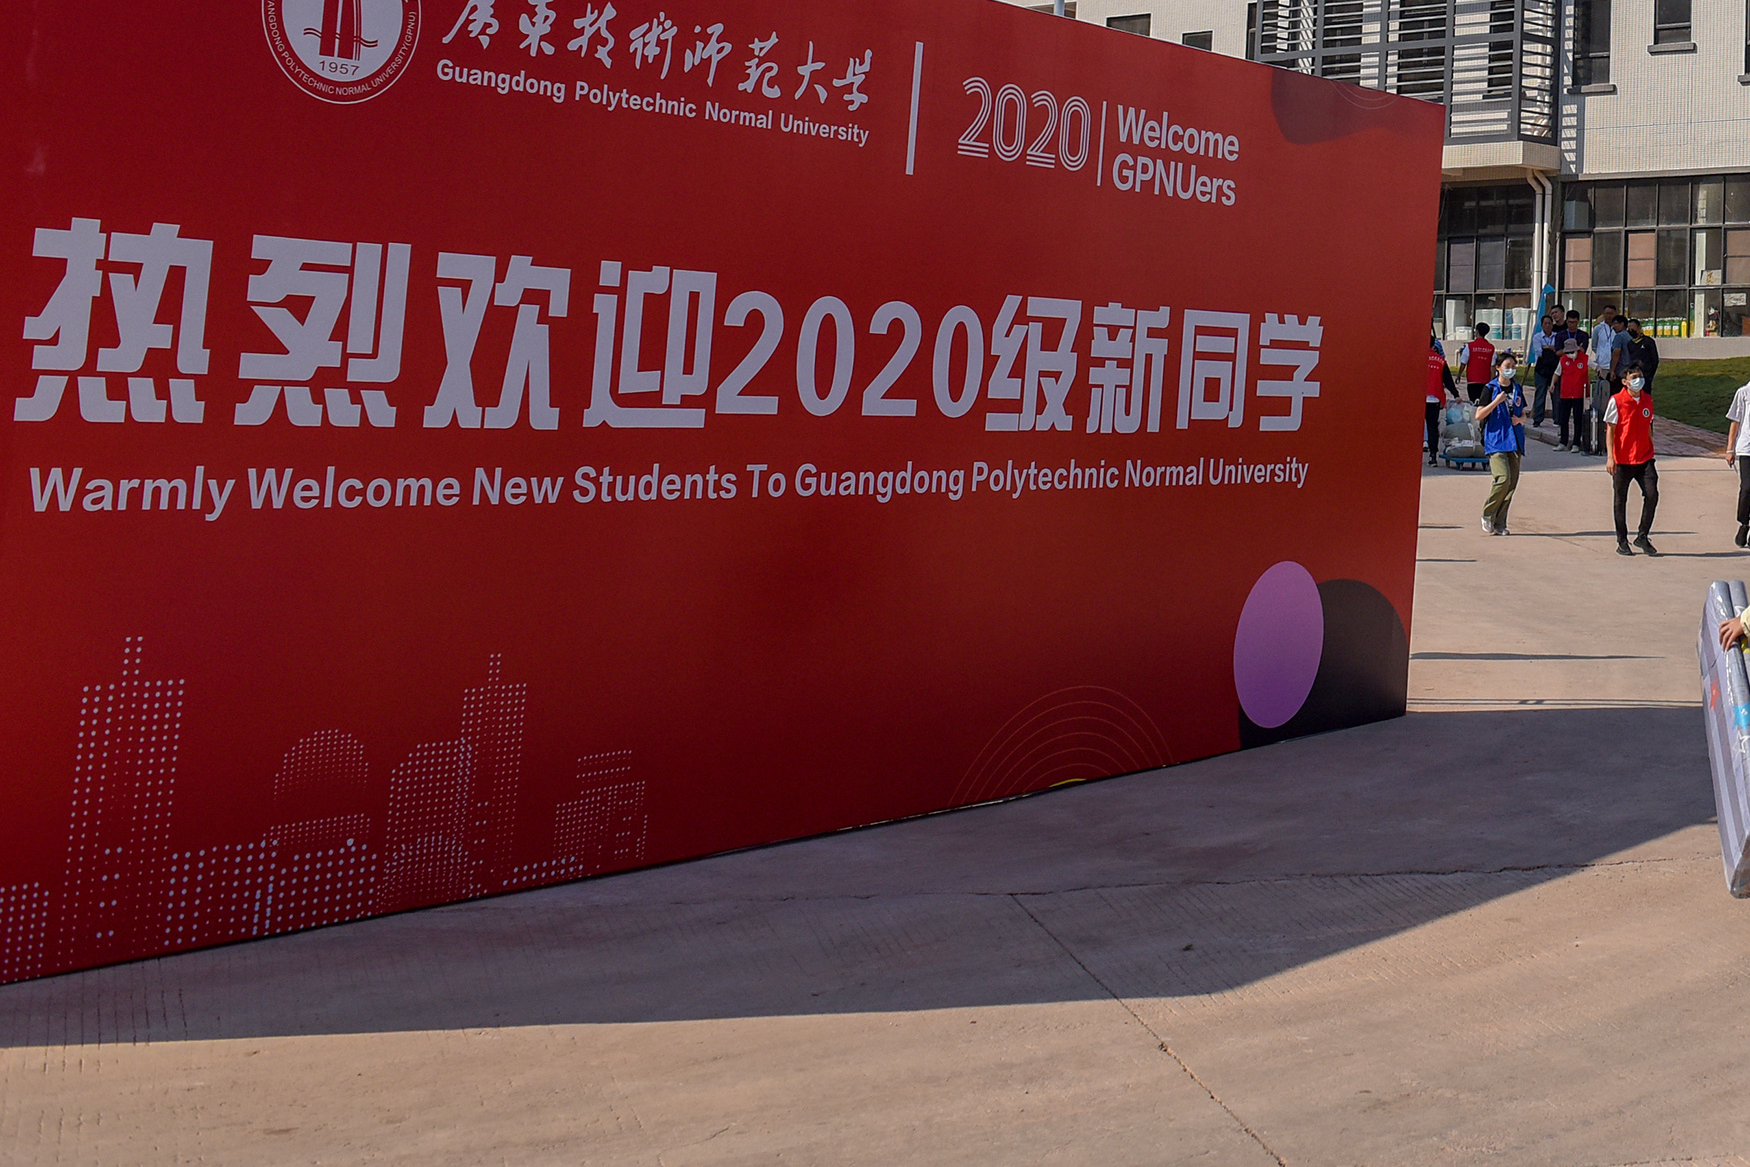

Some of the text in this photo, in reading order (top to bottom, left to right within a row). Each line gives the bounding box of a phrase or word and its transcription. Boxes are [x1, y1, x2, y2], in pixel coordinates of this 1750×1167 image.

[282, 50, 335, 95] POLYTECHNIC
[335, 82, 372, 96] NORMAL
[319, 60, 360, 76] 1957
[436, 59, 870, 148] Guangdong Polytechnic Normal University
[957, 76, 1091, 172] 2020
[1117, 104, 1240, 162] Welcome
[1112, 152, 1237, 207] GPNUers
[13, 217, 1324, 434] 热烈欢迎2020级新同学
[29, 457, 1310, 521] Warmly Welcome New Students To Guangdong Polytechnic Normal University
